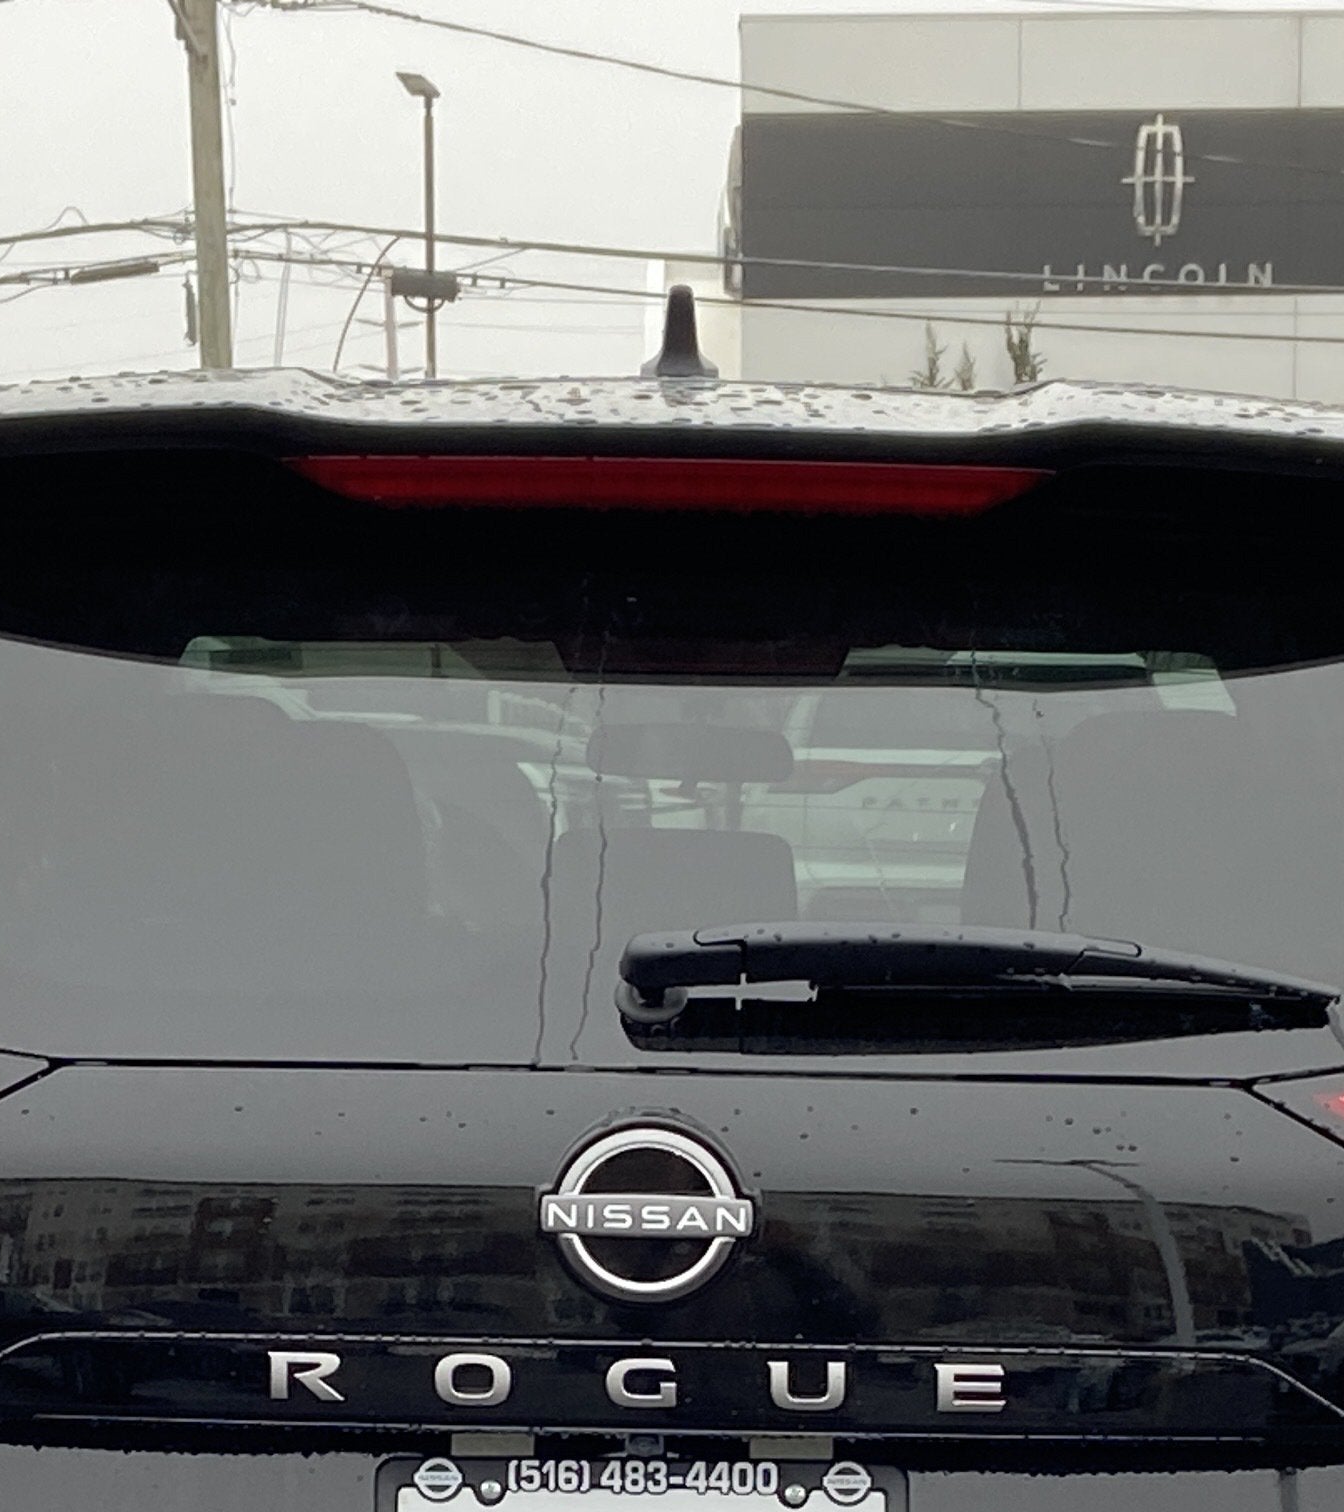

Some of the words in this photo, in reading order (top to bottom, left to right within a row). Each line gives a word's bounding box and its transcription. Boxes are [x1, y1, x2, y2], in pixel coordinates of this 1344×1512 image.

[546, 1202, 749, 1233] NISSAN
[267, 1350, 1007, 1413] ROGUE
[508, 1460, 591, 1493] (516)
[600, 1461, 780, 1495] 483-4400
